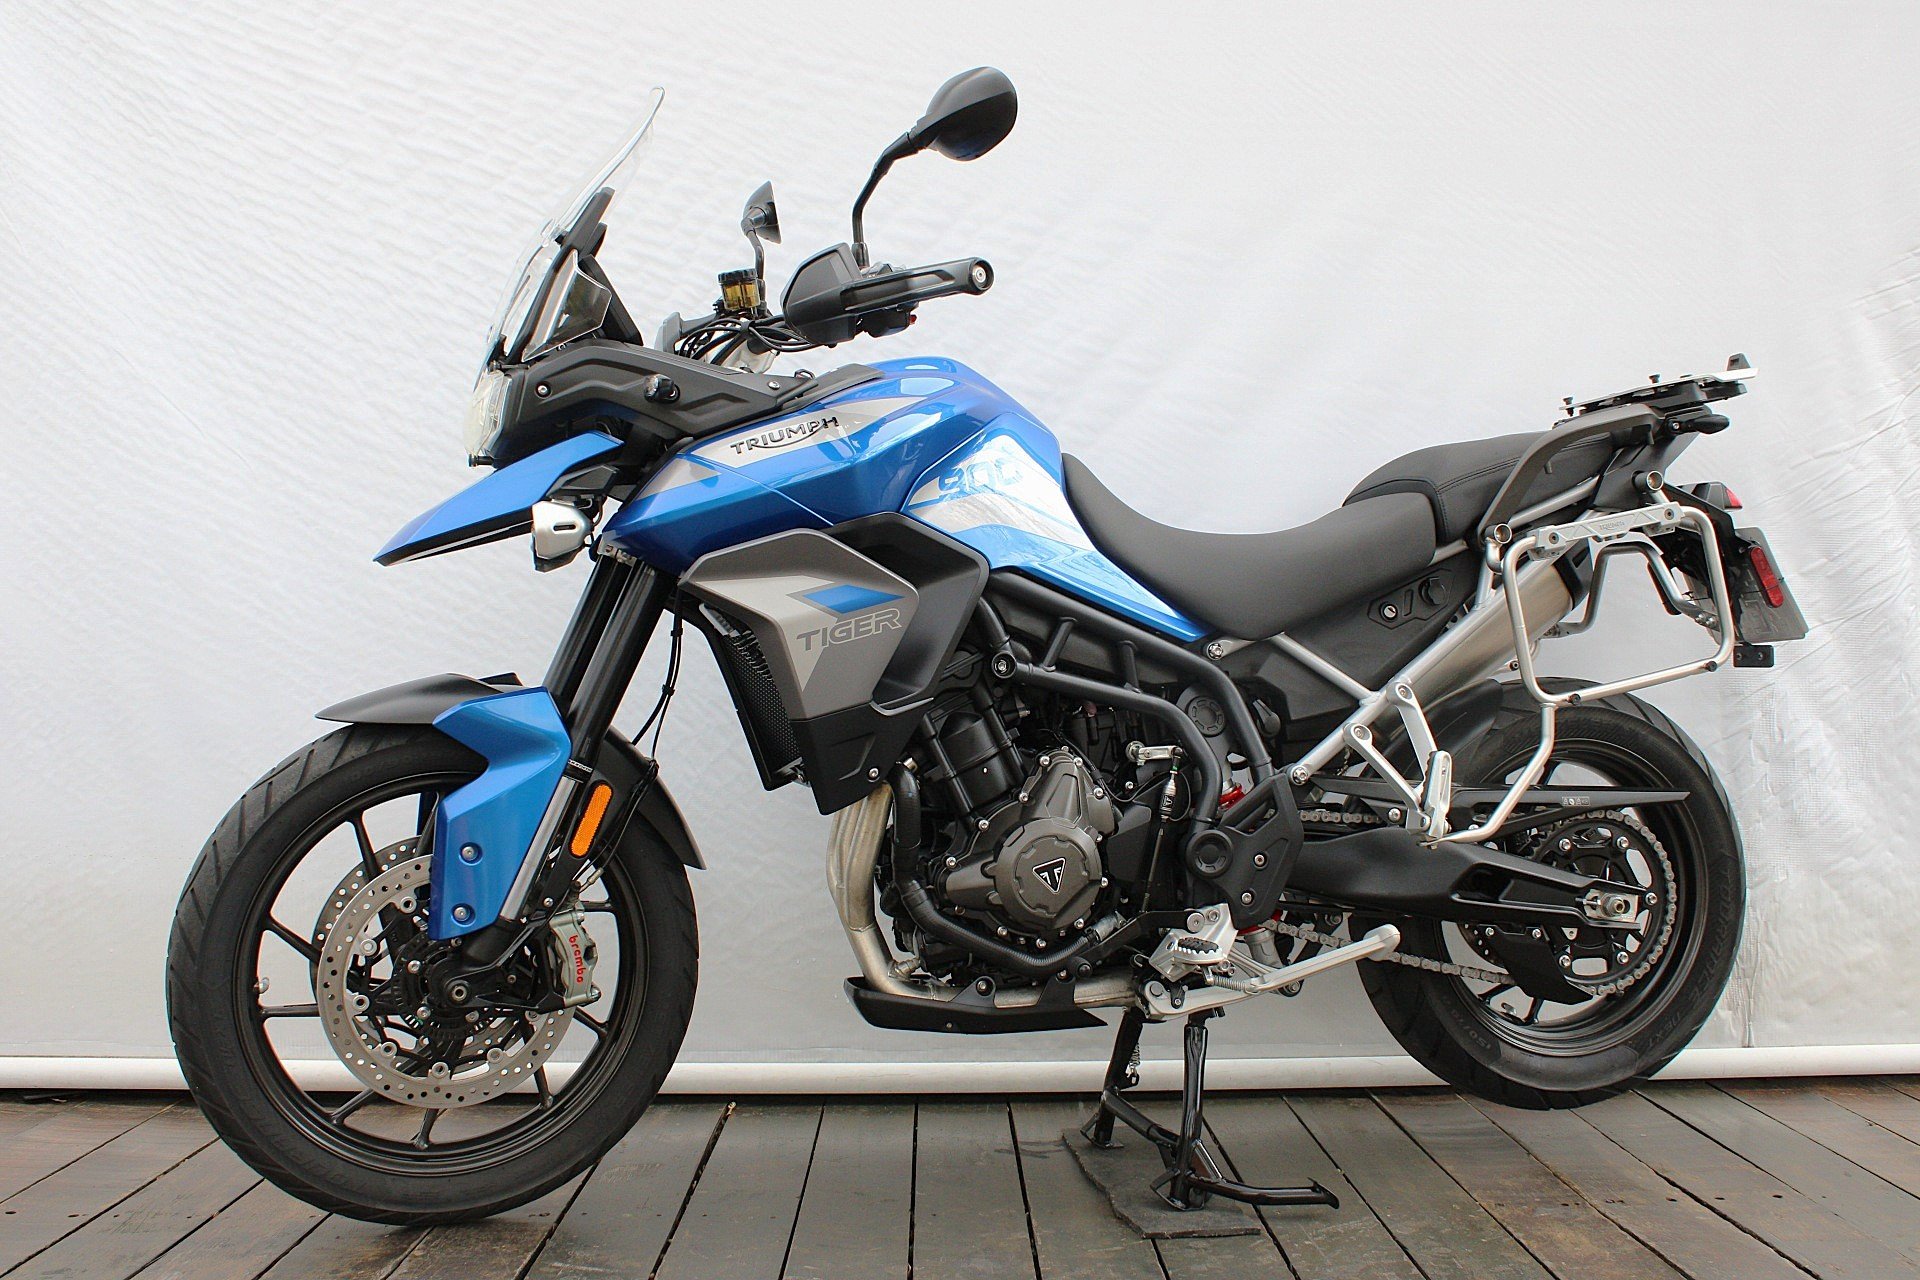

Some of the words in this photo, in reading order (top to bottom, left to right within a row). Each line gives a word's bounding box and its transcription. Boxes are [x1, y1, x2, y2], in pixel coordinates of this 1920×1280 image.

[730, 416, 840, 455] TRIUMPH
[796, 607, 902, 652] TIGER
[568, 934, 586, 984] brembo
